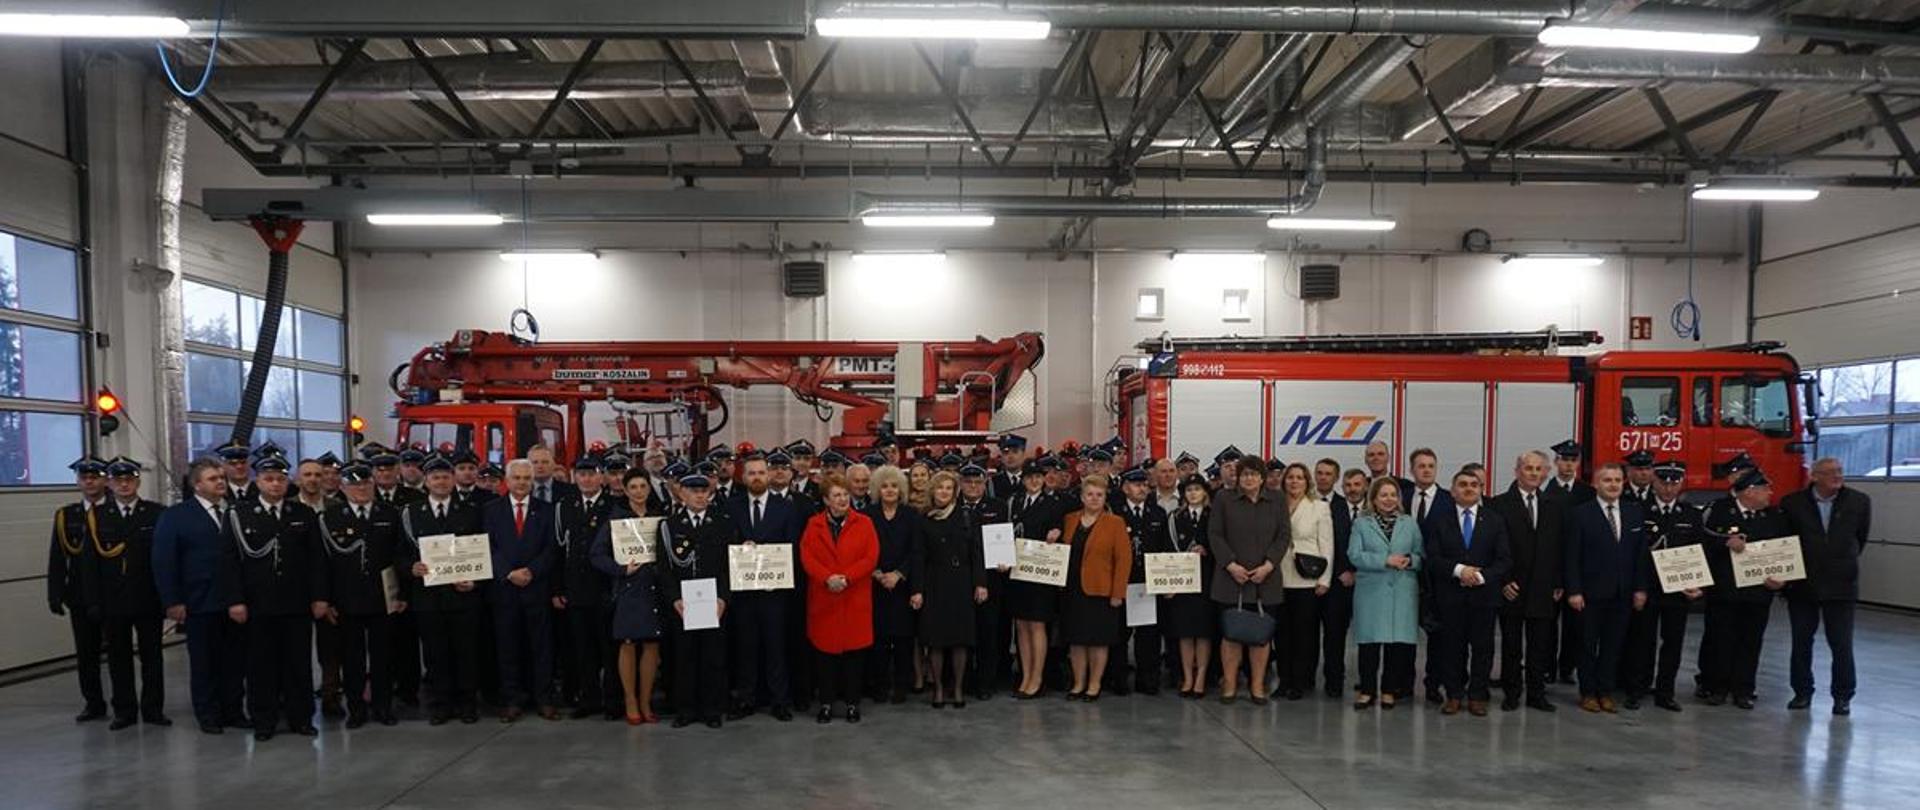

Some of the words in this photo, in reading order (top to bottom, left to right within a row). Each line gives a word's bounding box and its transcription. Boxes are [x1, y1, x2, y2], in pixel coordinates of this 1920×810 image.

[602, 370, 648, 379] KOSZALIN
[1620, 431, 1648, 451] 671
[1661, 431, 1682, 451] 25
